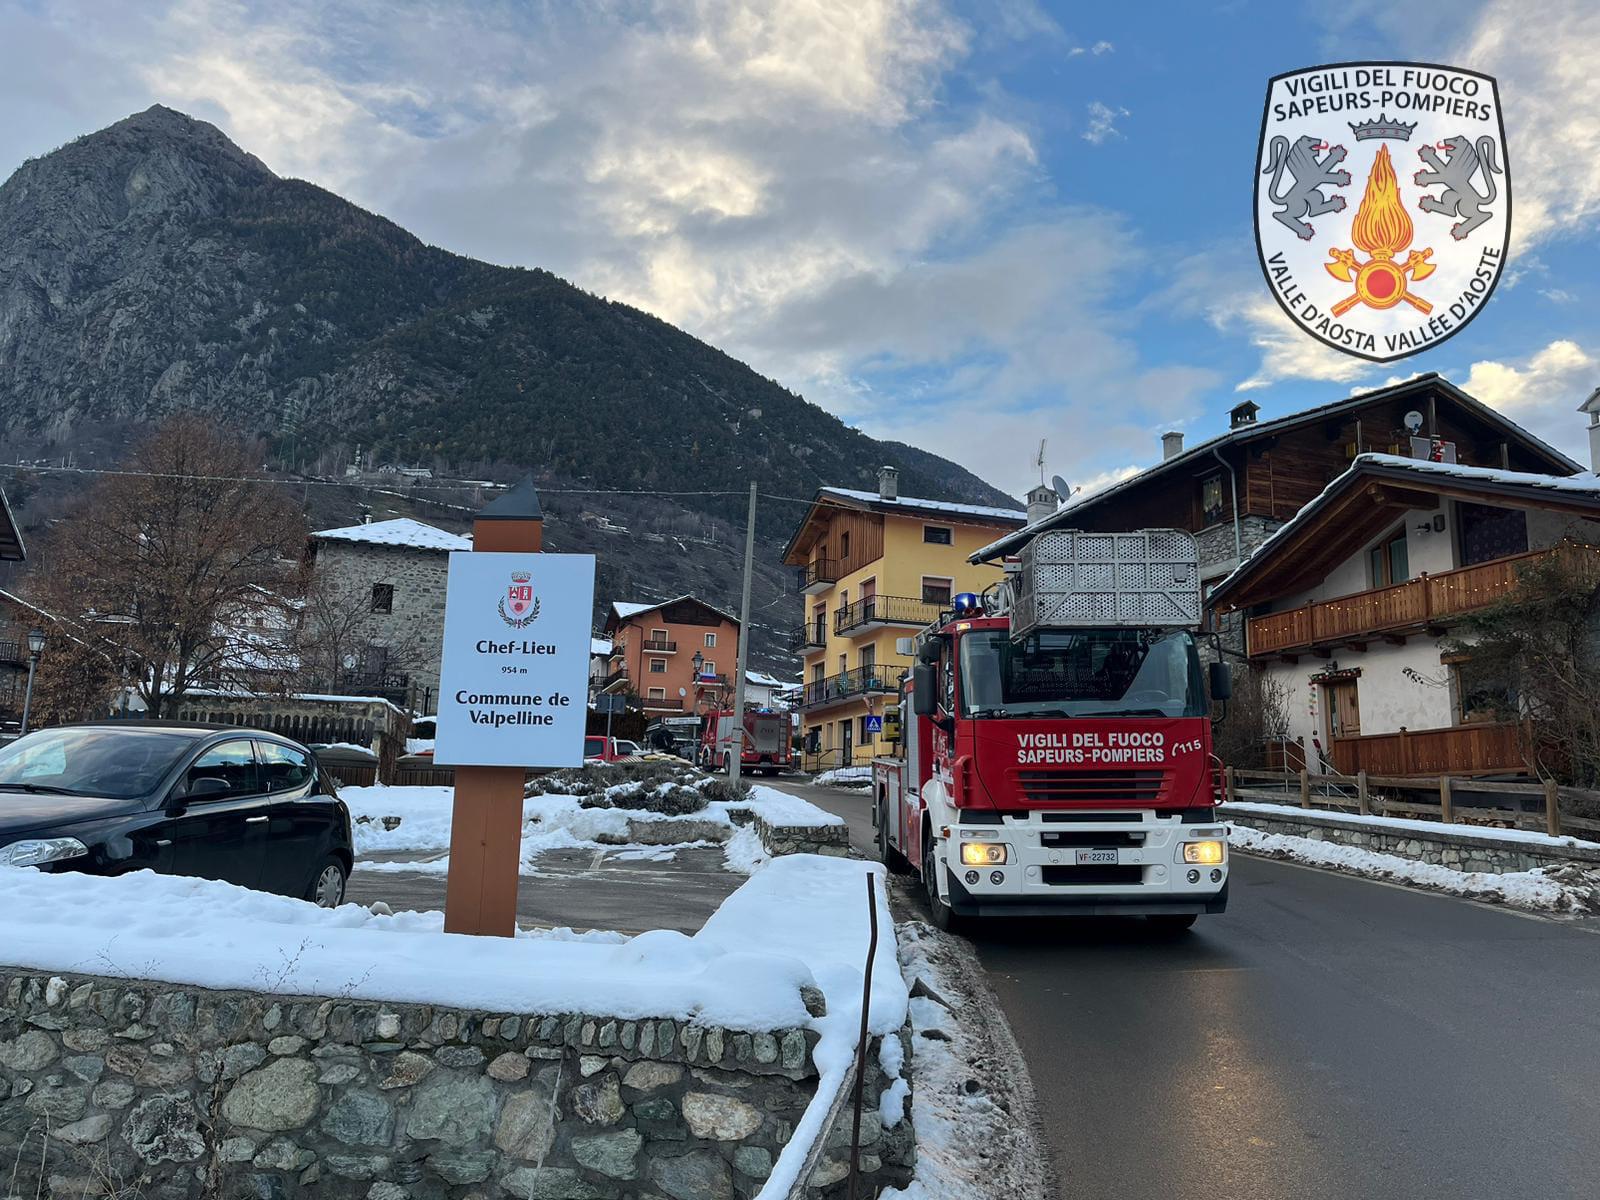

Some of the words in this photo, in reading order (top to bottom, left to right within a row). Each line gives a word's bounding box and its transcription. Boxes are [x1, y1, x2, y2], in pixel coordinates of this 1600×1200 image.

[476, 640, 556, 655] Chef-Lieu
[501, 666, 517, 674] 954
[455, 690, 542, 706] Commune
[548, 693, 570, 706] de
[469, 710, 554, 728] Valpelline
[1017, 733, 1067, 748] VIGILI
[1072, 733, 1104, 747] DEL
[1108, 732, 1164, 747] FUOCO
[1178, 739, 1202, 754] 115
[1017, 748, 1165, 763] SAPEURS-POMPIERS
